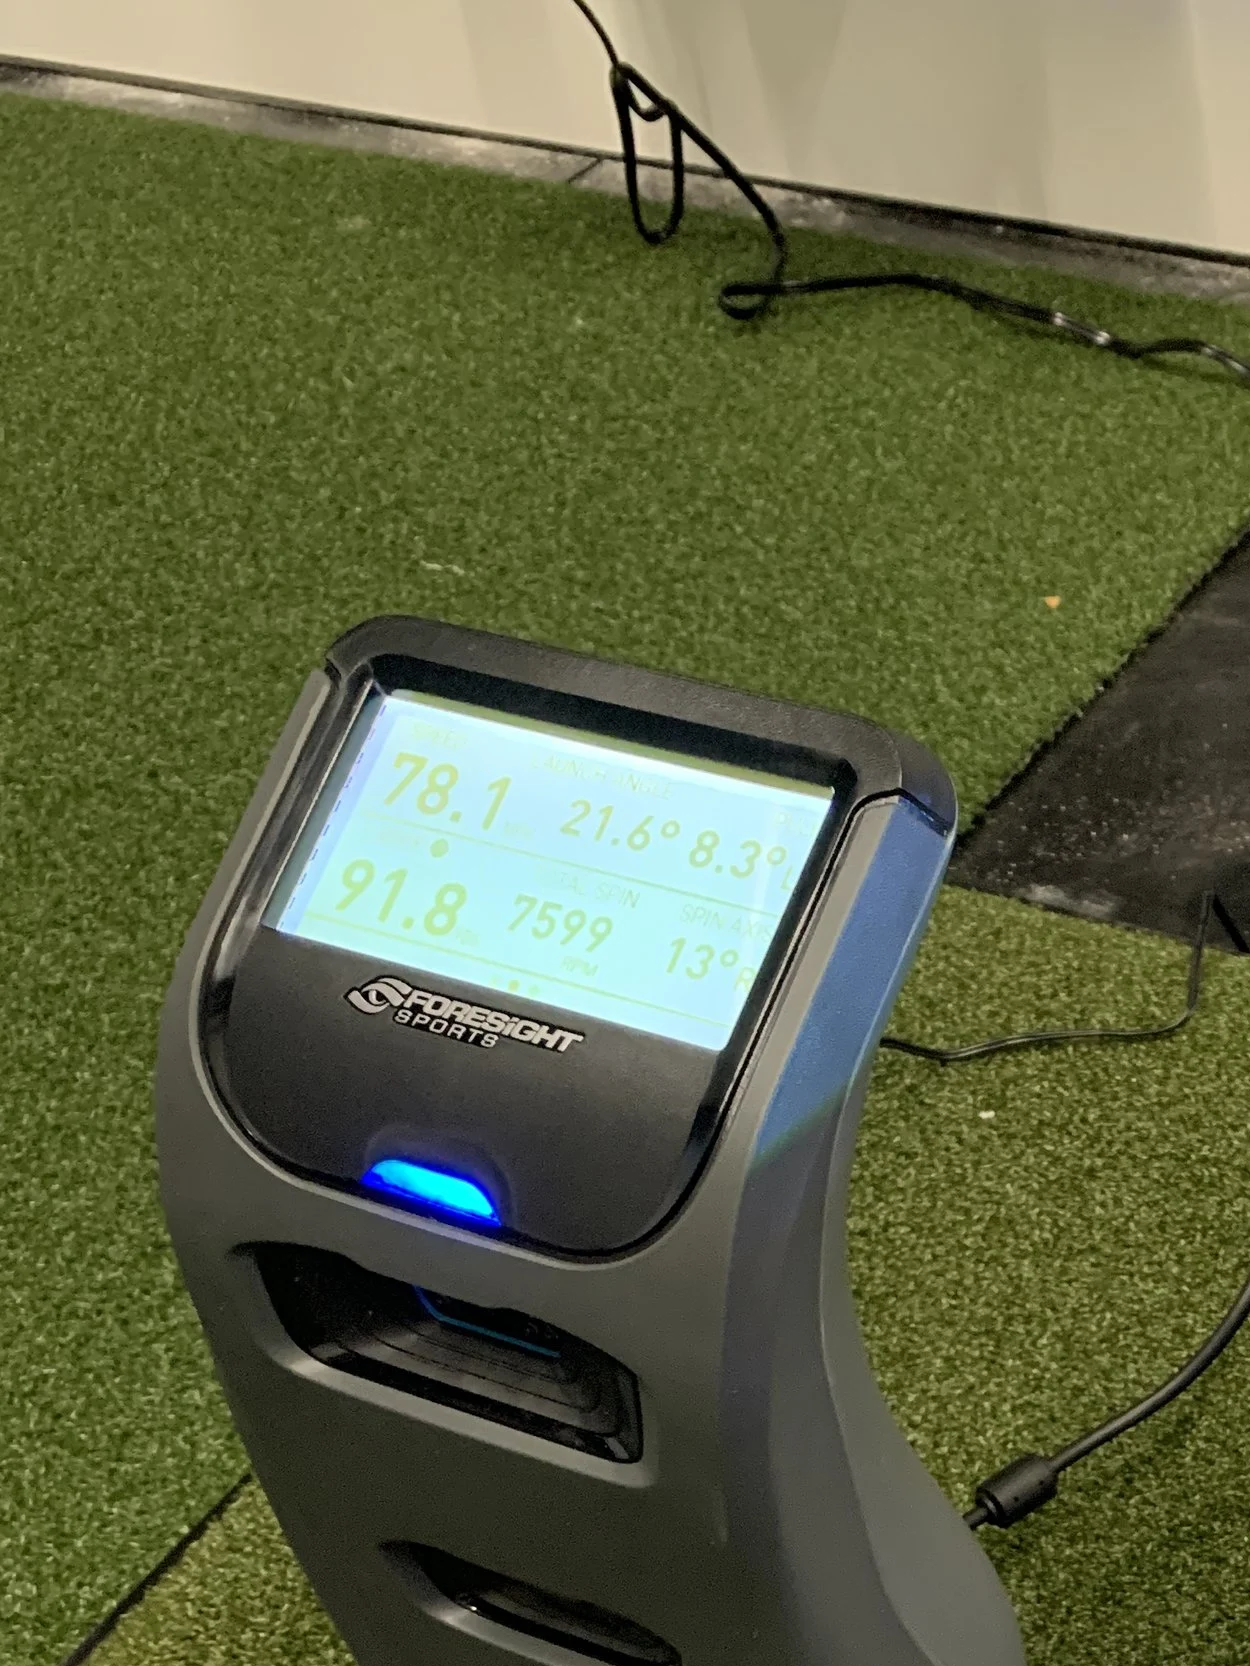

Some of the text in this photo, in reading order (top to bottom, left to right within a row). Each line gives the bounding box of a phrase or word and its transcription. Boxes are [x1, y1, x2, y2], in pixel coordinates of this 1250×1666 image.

[383, 751, 512, 832] 78.1
[559, 799, 681, 852] 21.6°
[688, 829, 788, 880] 8.3°
[335, 858, 468, 937] 91.8
[506, 892, 614, 954] 7599
[679, 902, 724, 931] SPIN
[665, 936, 739, 981] 13°
[394, 1009, 500, 1048] SPORTS
